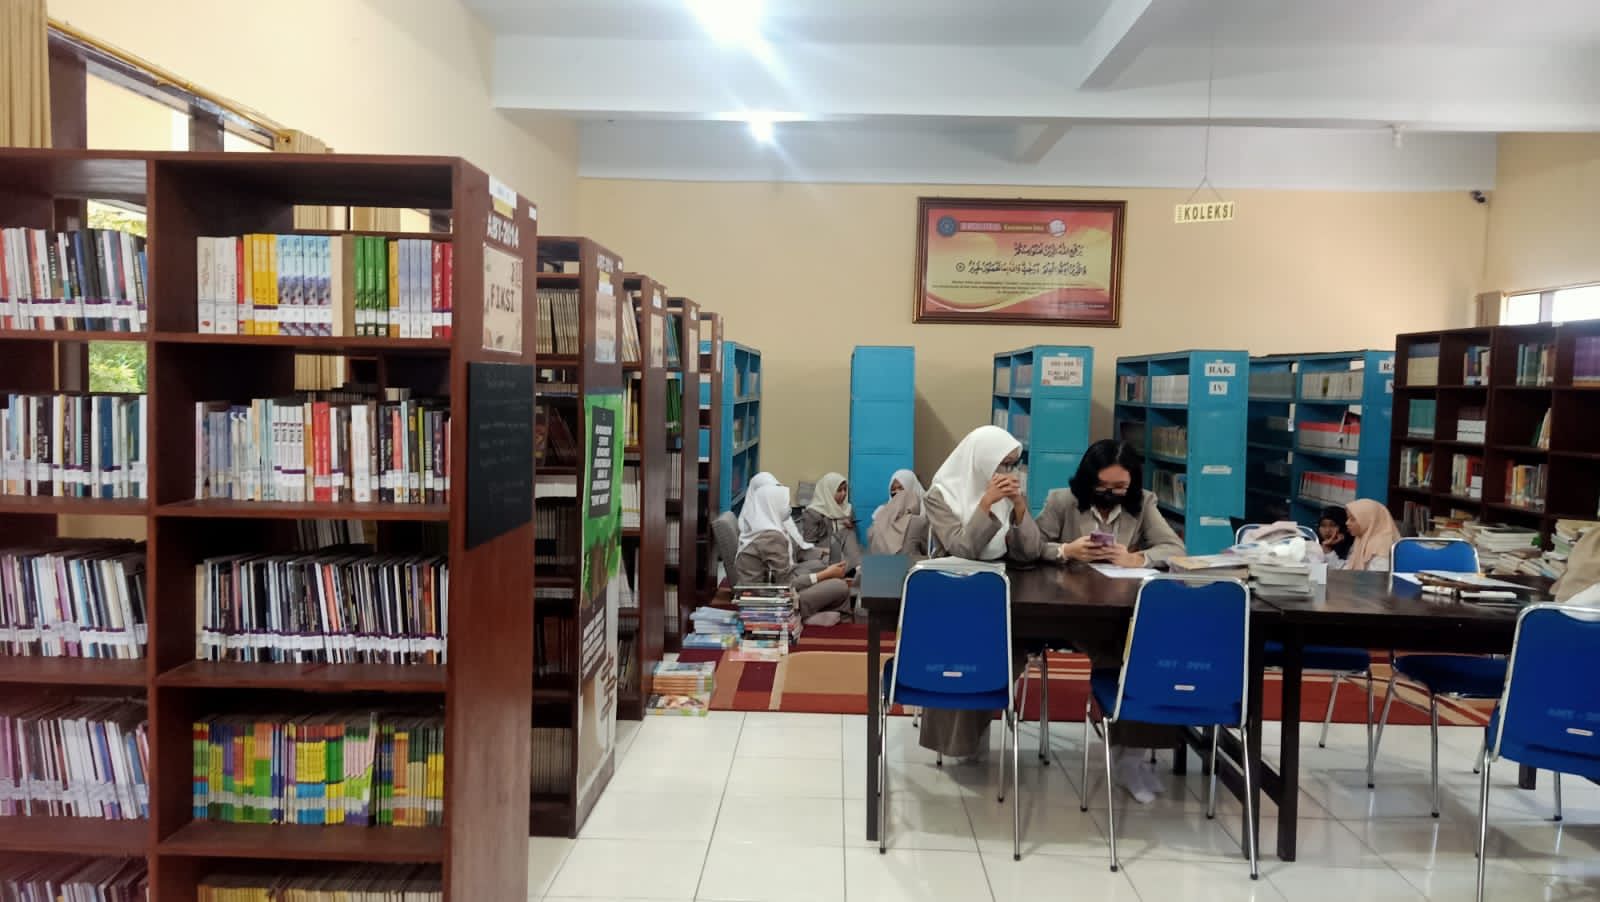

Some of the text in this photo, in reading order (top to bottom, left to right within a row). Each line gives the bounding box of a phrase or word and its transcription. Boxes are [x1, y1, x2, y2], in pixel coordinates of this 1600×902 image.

[1184, 204, 1233, 220] KOLEKSI
[490, 283, 515, 313] FIKSI
[1208, 365, 1231, 375] RAK
